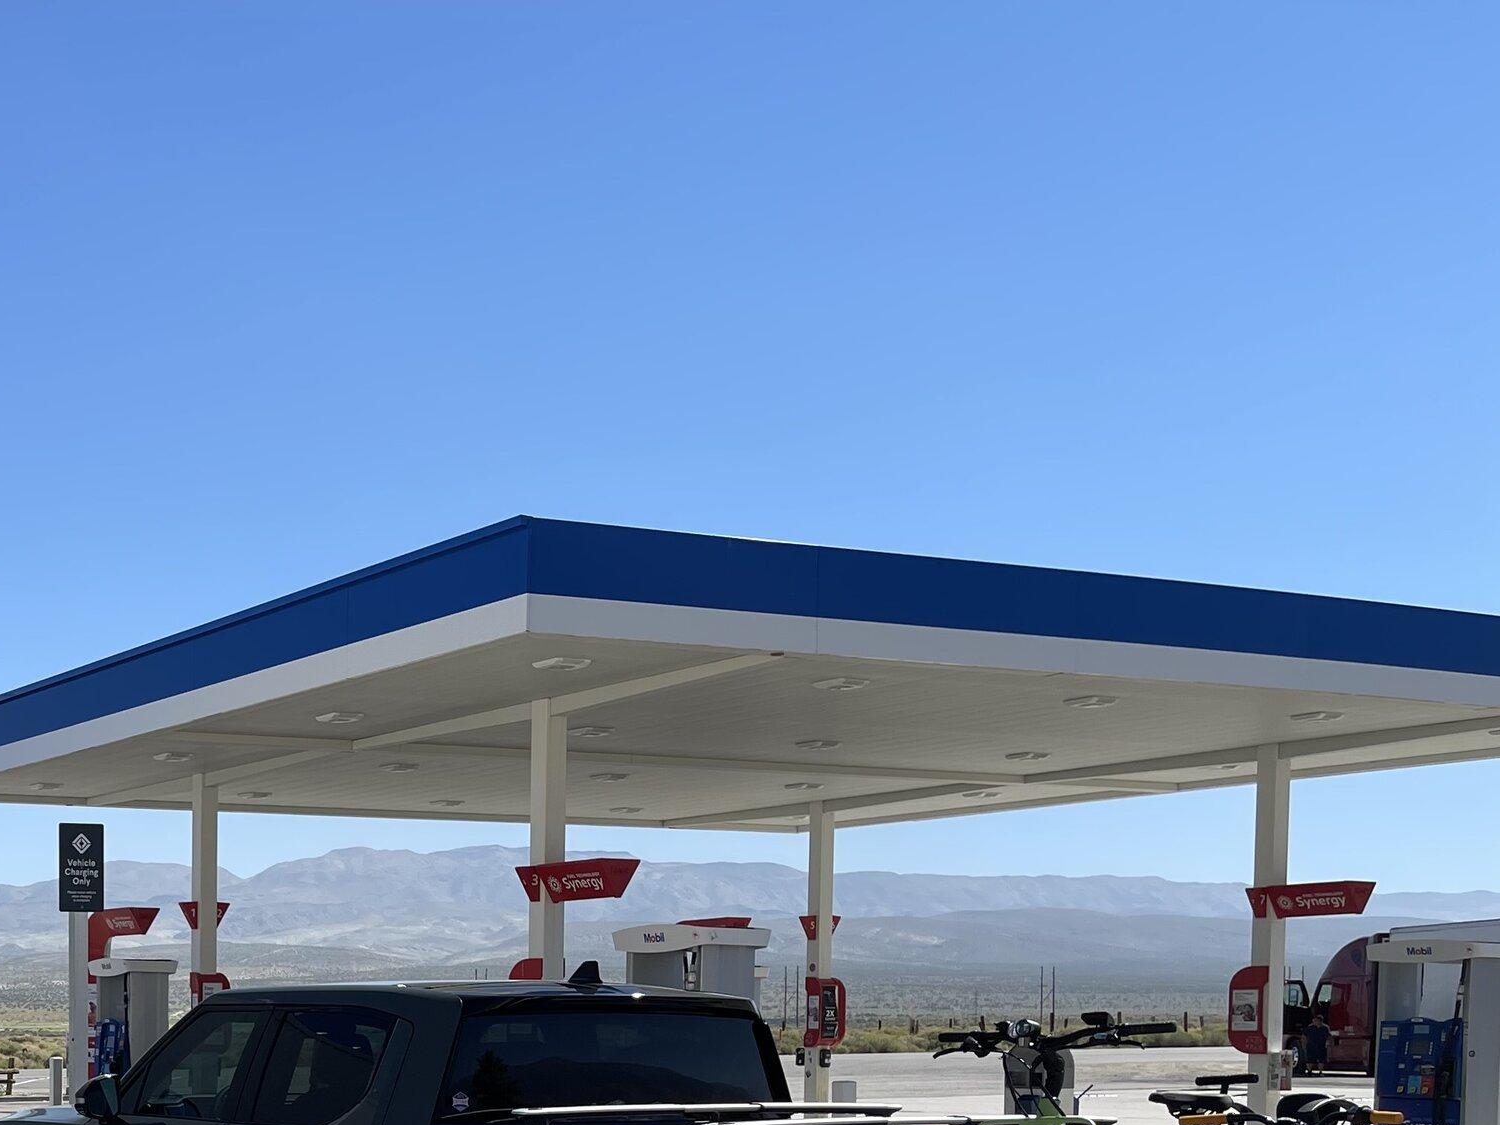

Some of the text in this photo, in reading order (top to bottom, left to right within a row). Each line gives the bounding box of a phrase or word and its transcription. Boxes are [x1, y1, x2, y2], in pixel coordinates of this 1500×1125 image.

[67, 859, 96, 867] Vehicle
[64, 867, 99, 878] Charging
[72, 877, 91, 887] Only
[531, 874, 539, 886] 3
[561, 876, 604, 892] Synergy
[1295, 896, 1346, 909] Synergy
[643, 932, 665, 943] Mobil
[1407, 946, 1433, 956] Mobil
